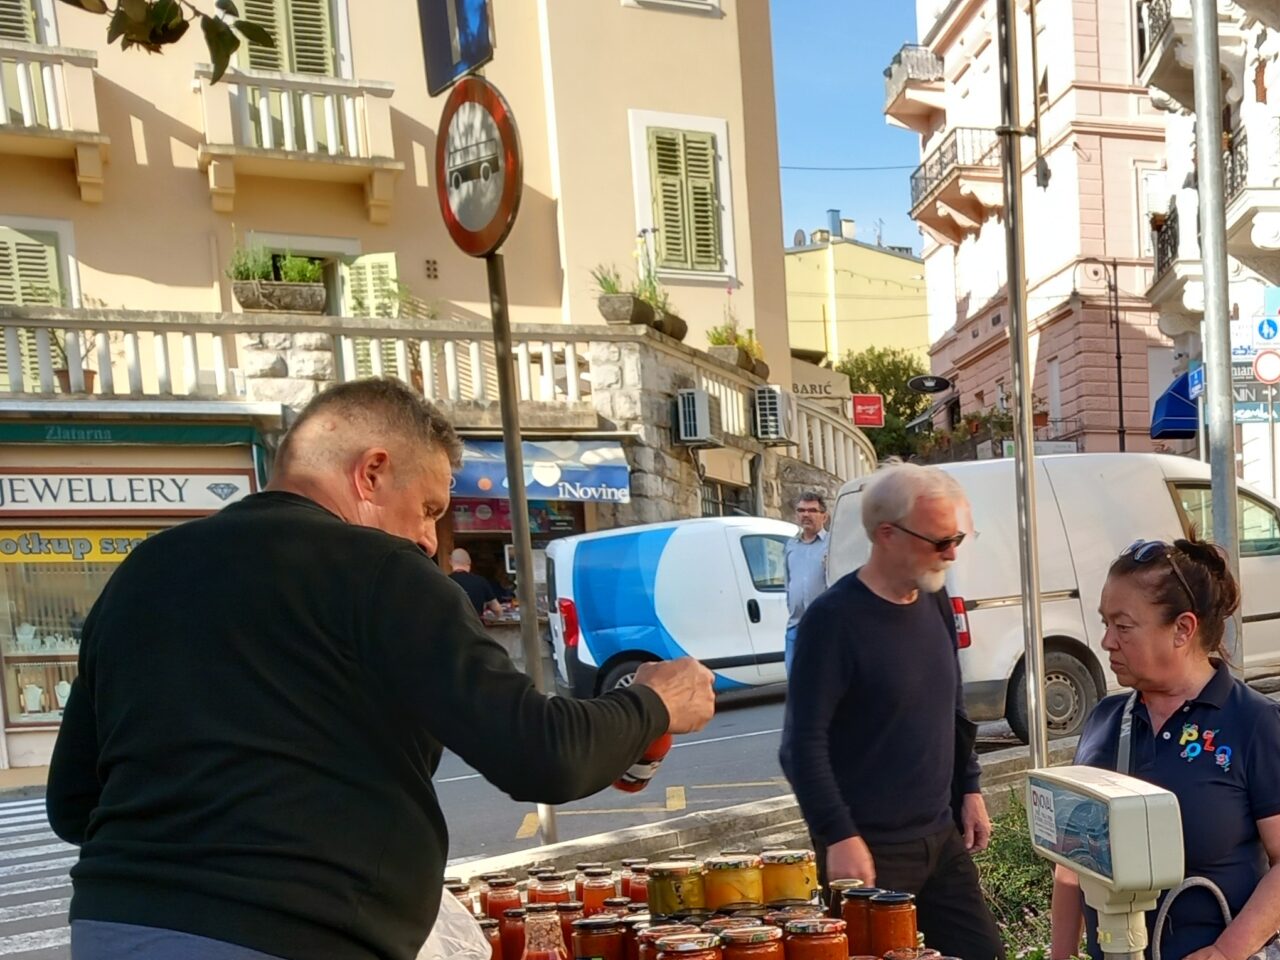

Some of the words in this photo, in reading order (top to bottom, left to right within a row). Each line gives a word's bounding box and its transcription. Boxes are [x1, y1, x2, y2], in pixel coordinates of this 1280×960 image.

[792, 381, 832, 395] BARIĆ
[45, 426, 112, 441] Zlatarna
[0, 478, 189, 506] JEWELLERY
[557, 481, 629, 501] iNovine
[0, 532, 93, 560] otkup
